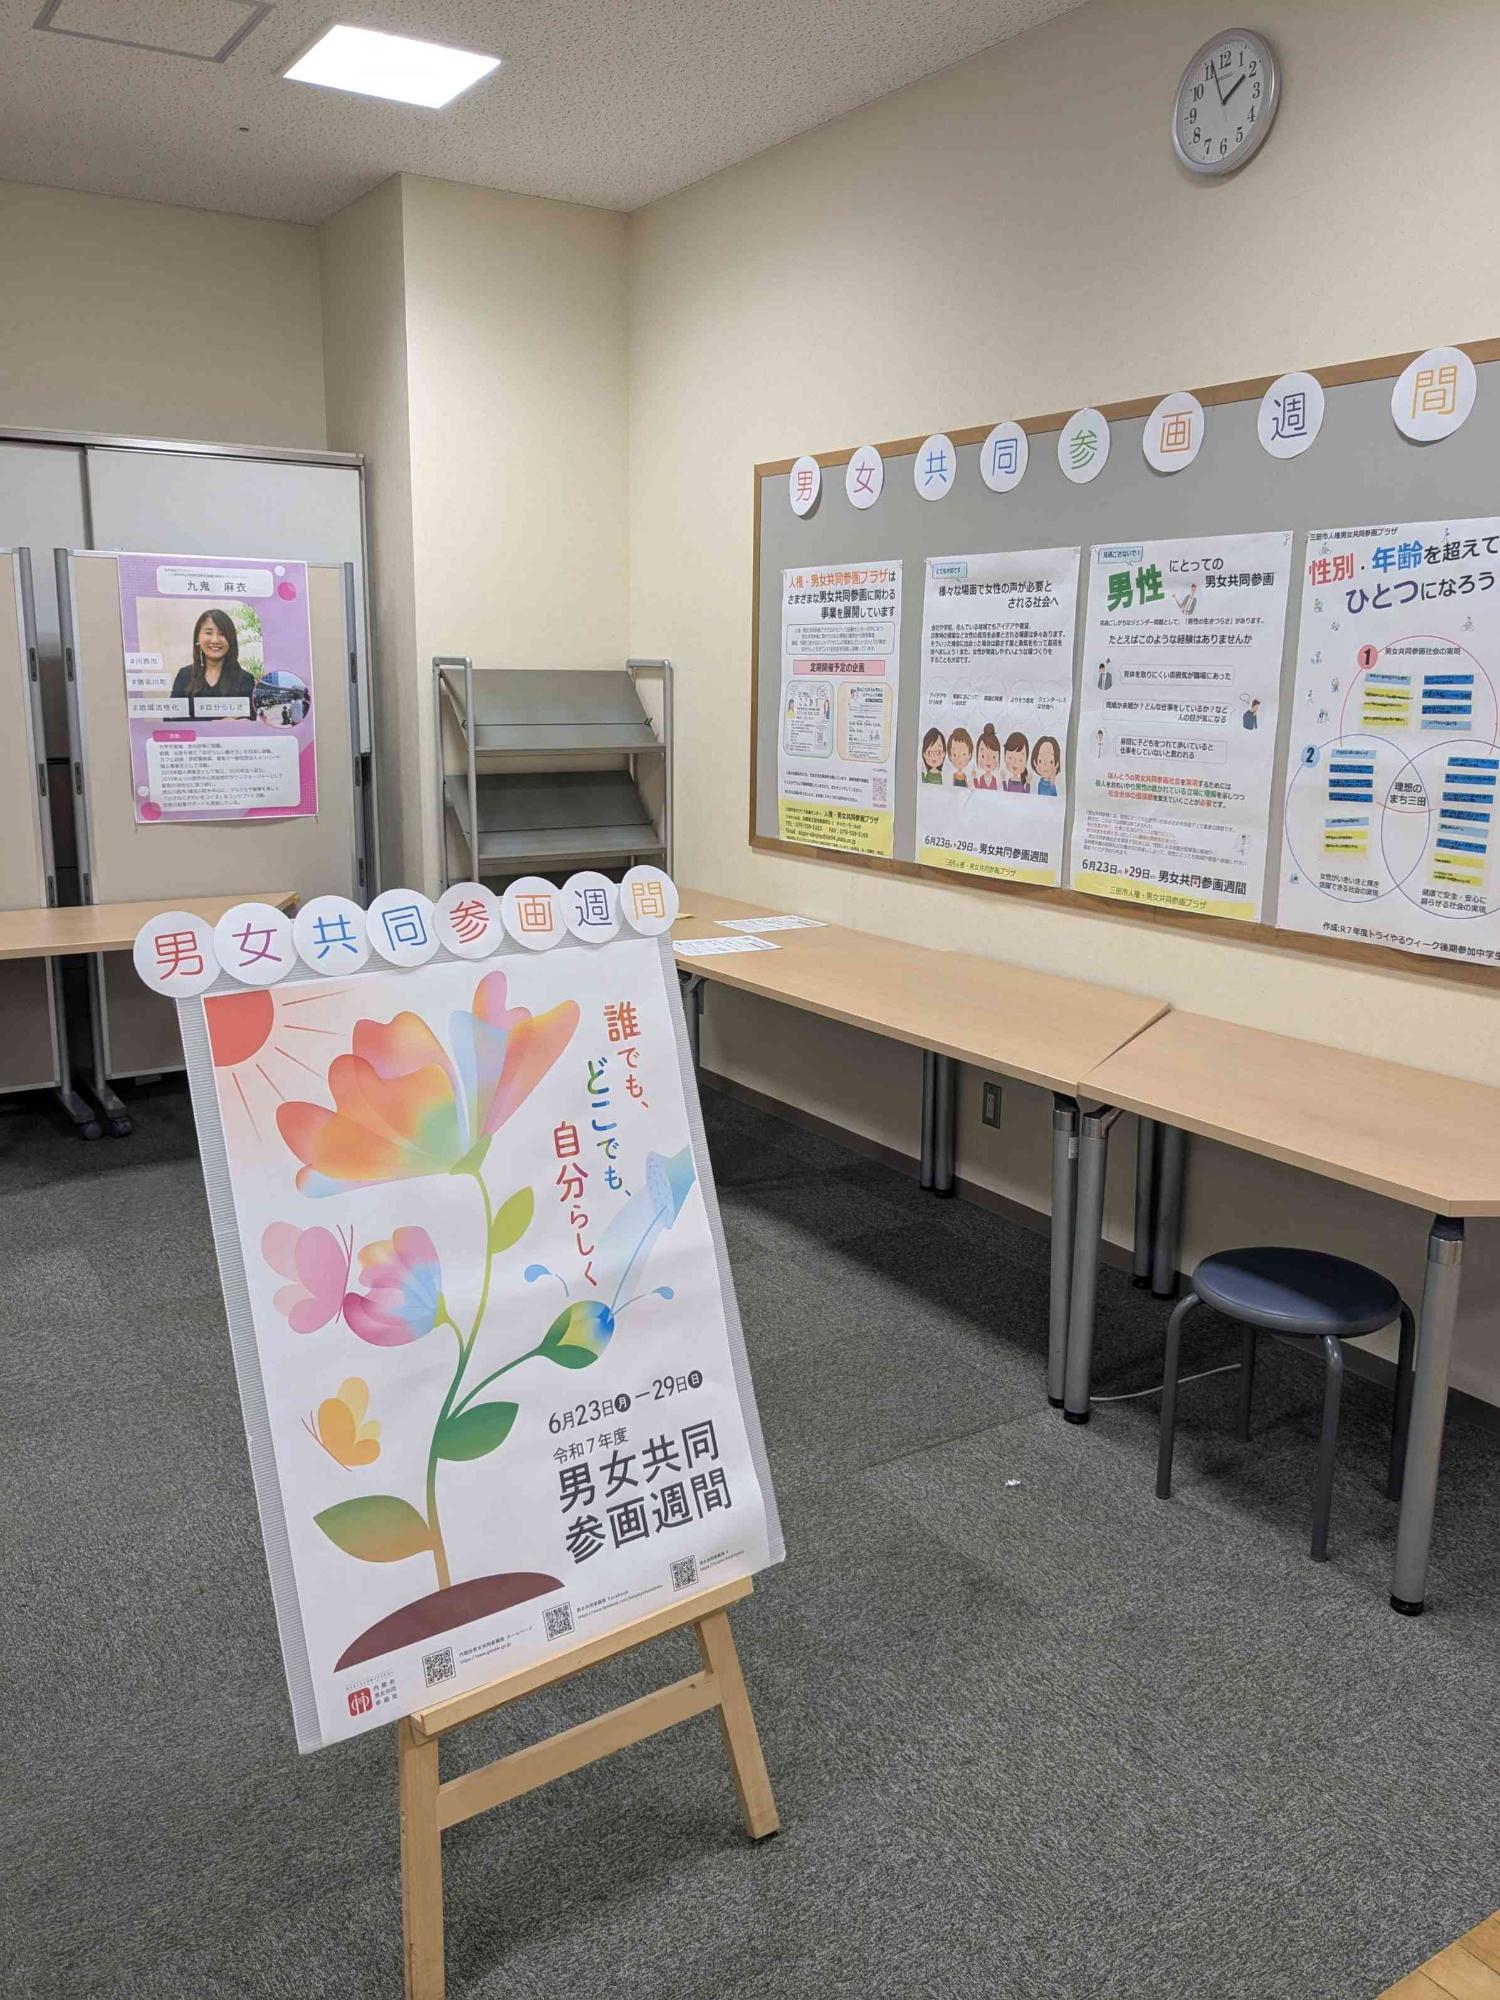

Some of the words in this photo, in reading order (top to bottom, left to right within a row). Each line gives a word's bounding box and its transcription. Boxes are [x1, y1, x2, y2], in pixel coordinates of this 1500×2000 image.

[1219, 51, 1231, 70] 12
[1239, 51, 1244, 67] 1
[1248, 60, 1256, 78] 2
[1193, 83, 1204, 102] 10
[1252, 82, 1260, 99] 3
[1189, 107, 1197, 124] 9
[1247, 105, 1256, 122] 4
[1193, 127, 1200, 144] 8
[1236, 127, 1243, 143] 5
[1204, 138, 1212, 155] 7
[1220, 138, 1227, 155] 6
[796, 471, 815, 503] 男
[853, 461, 876, 495] 女
[925, 450, 949, 486] 共
[992, 438, 1018, 477] 同
[1070, 429, 1100, 470] 参
[1161, 411, 1193, 454] 画
[1271, 393, 1309, 441] 週
[1411, 364, 1459, 419] 間
[1170, 558, 1224, 572] にとっての
[224, 582, 247, 592] 麻衣
[1108, 564, 1164, 612] 男性
[1205, 572, 1274, 588] 男女共同参画
[1346, 571, 1495, 614] ひとつになろう
[1008, 596, 1058, 608] される社会へ
[1364, 648, 1371, 665] 1
[1306, 748, 1314, 763] 2
[1394, 782, 1422, 793] 理想の
[1390, 794, 1426, 806] まち三田
[979, 843, 1048, 864] 男女共同参画週間
[1158, 870, 1246, 895] 男女共同参画週間
[154, 931, 204, 981] 男
[231, 923, 283, 967] 女
[312, 914, 358, 959] 共
[382, 905, 429, 952] 同
[449, 900, 490, 946] 参
[514, 893, 554, 934] 画
[574, 888, 613, 927] 週
[630, 882, 665, 921] 間
[604, 1001, 648, 1108] 誰でも、
[587, 1057, 631, 1196] どこでも、
[554, 1120, 598, 1286] 自分らしく
[552, 1427, 629, 1464] 令和7年度
[559, 1420, 719, 1513] 男女共同
[566, 1467, 732, 1564] 参画週間
